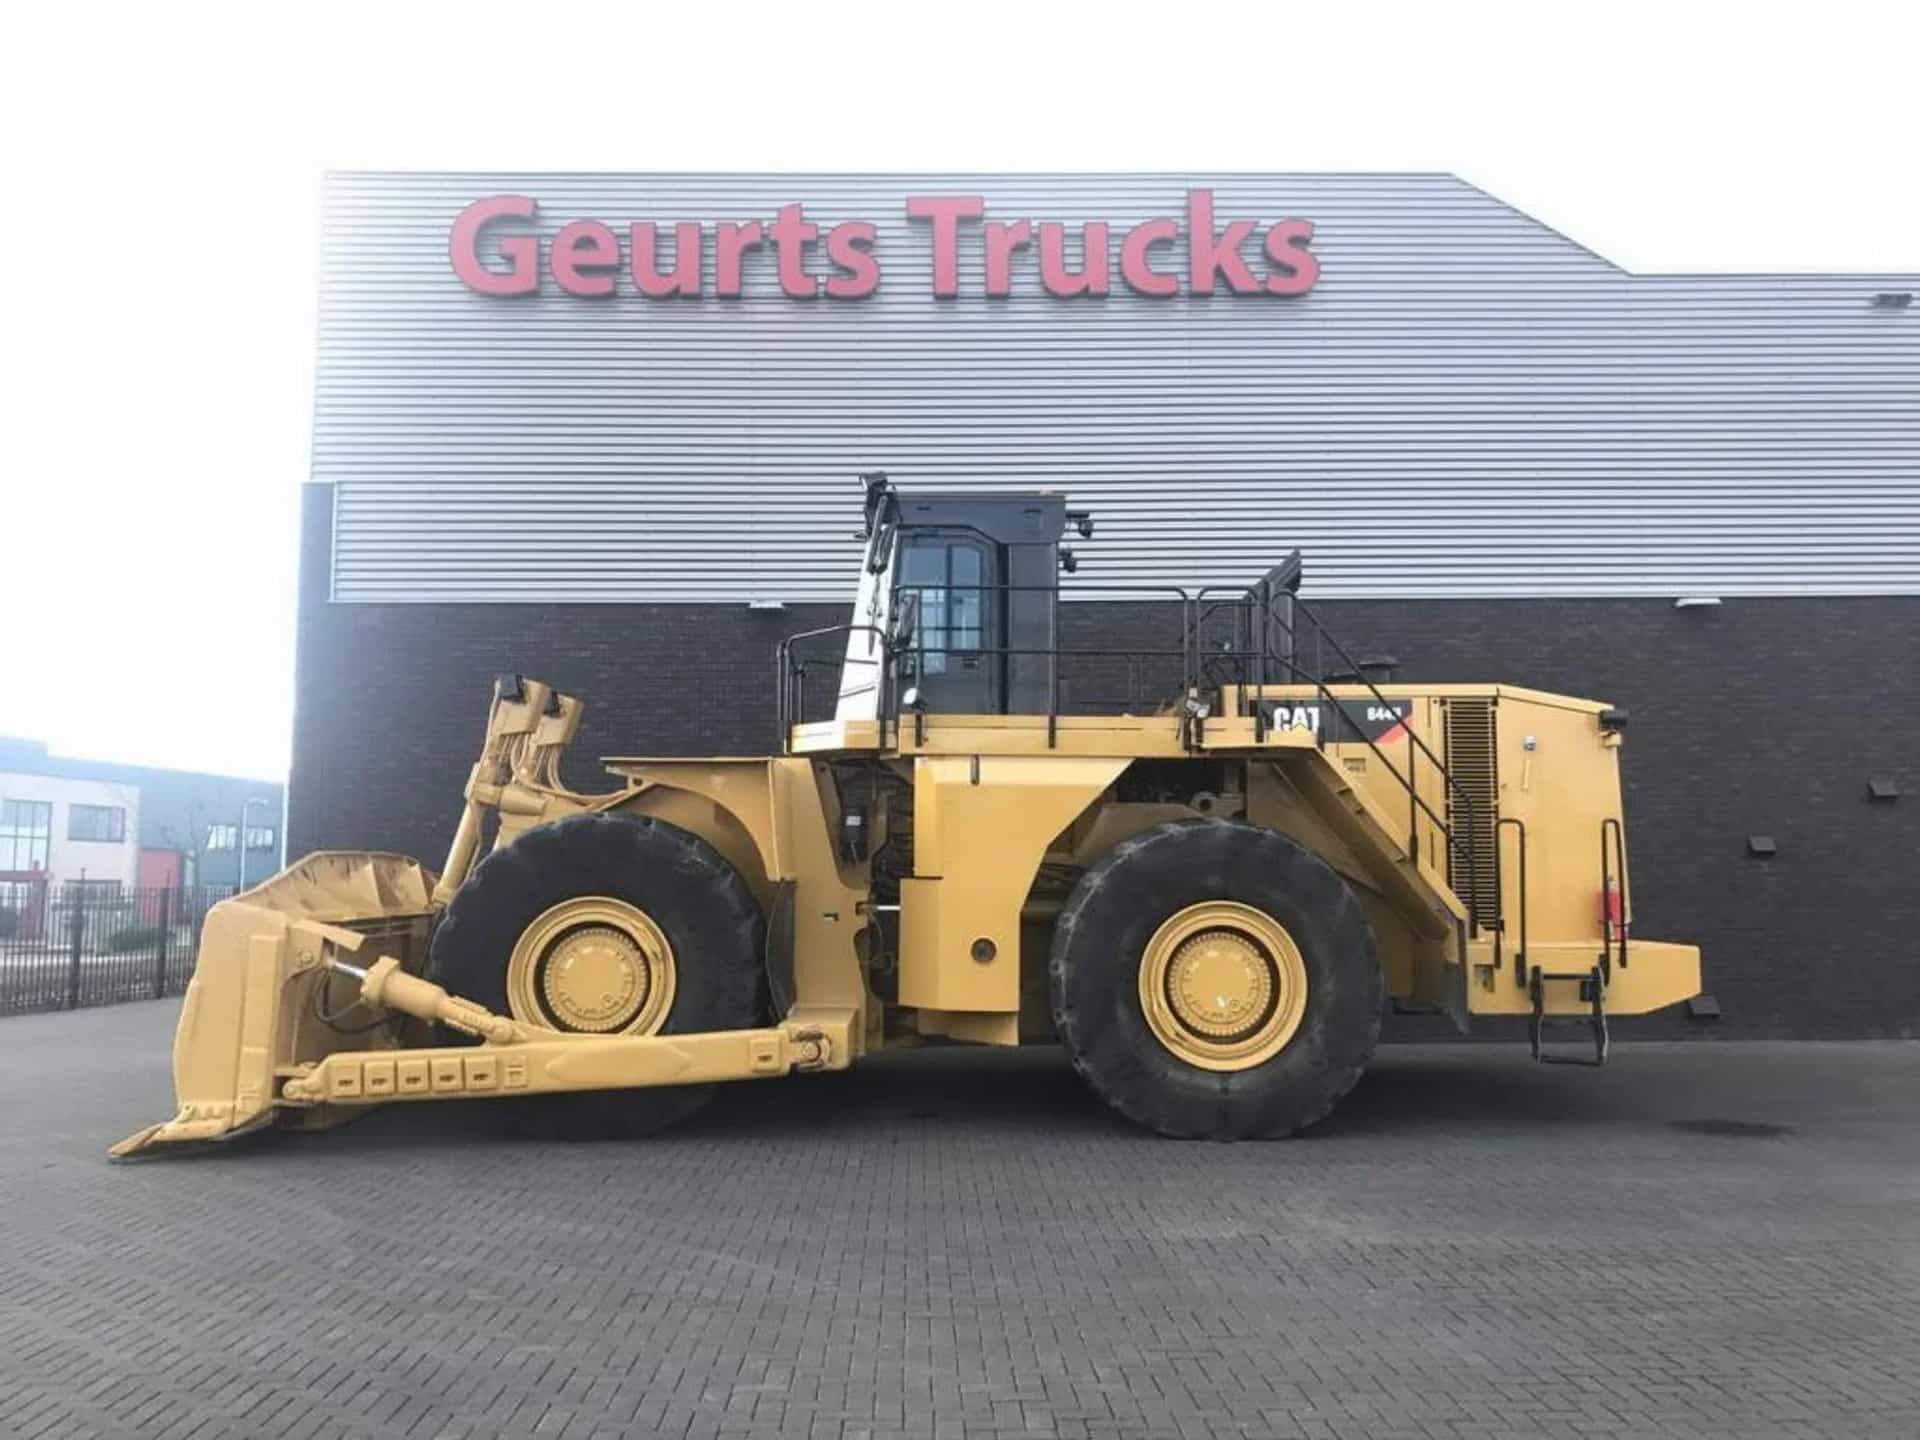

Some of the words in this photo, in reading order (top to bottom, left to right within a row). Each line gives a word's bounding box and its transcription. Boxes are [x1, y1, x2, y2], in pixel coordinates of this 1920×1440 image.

[450, 194, 881, 299] Geurts
[906, 188, 1321, 299] Trucks
[1273, 707, 1320, 733] CAT
